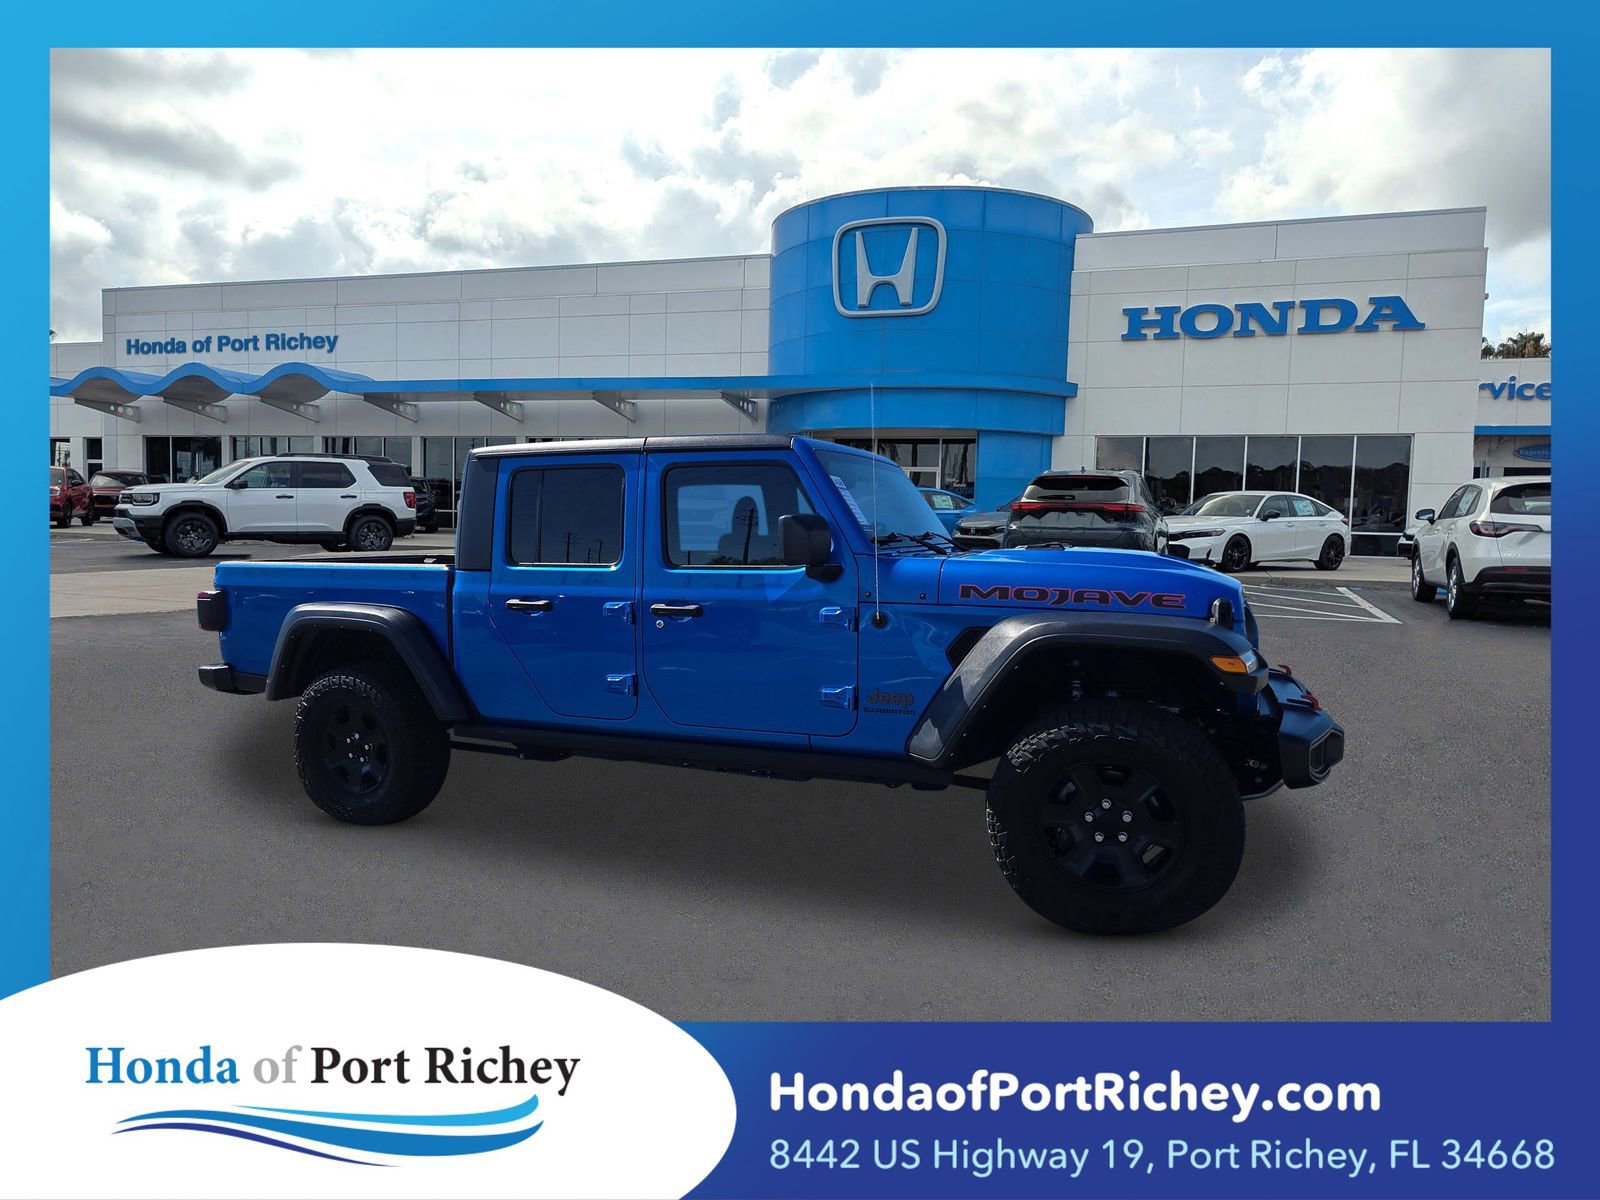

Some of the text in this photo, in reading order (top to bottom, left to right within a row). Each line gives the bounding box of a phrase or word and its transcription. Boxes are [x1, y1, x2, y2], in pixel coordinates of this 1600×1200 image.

[1120, 295, 1425, 341] HONDA
[125, 332, 338, 355] Honda of Port Richey
[959, 583, 1186, 609] MOJAVE
[866, 688, 914, 707] Jeep
[864, 707, 916, 715] GLADIATOR
